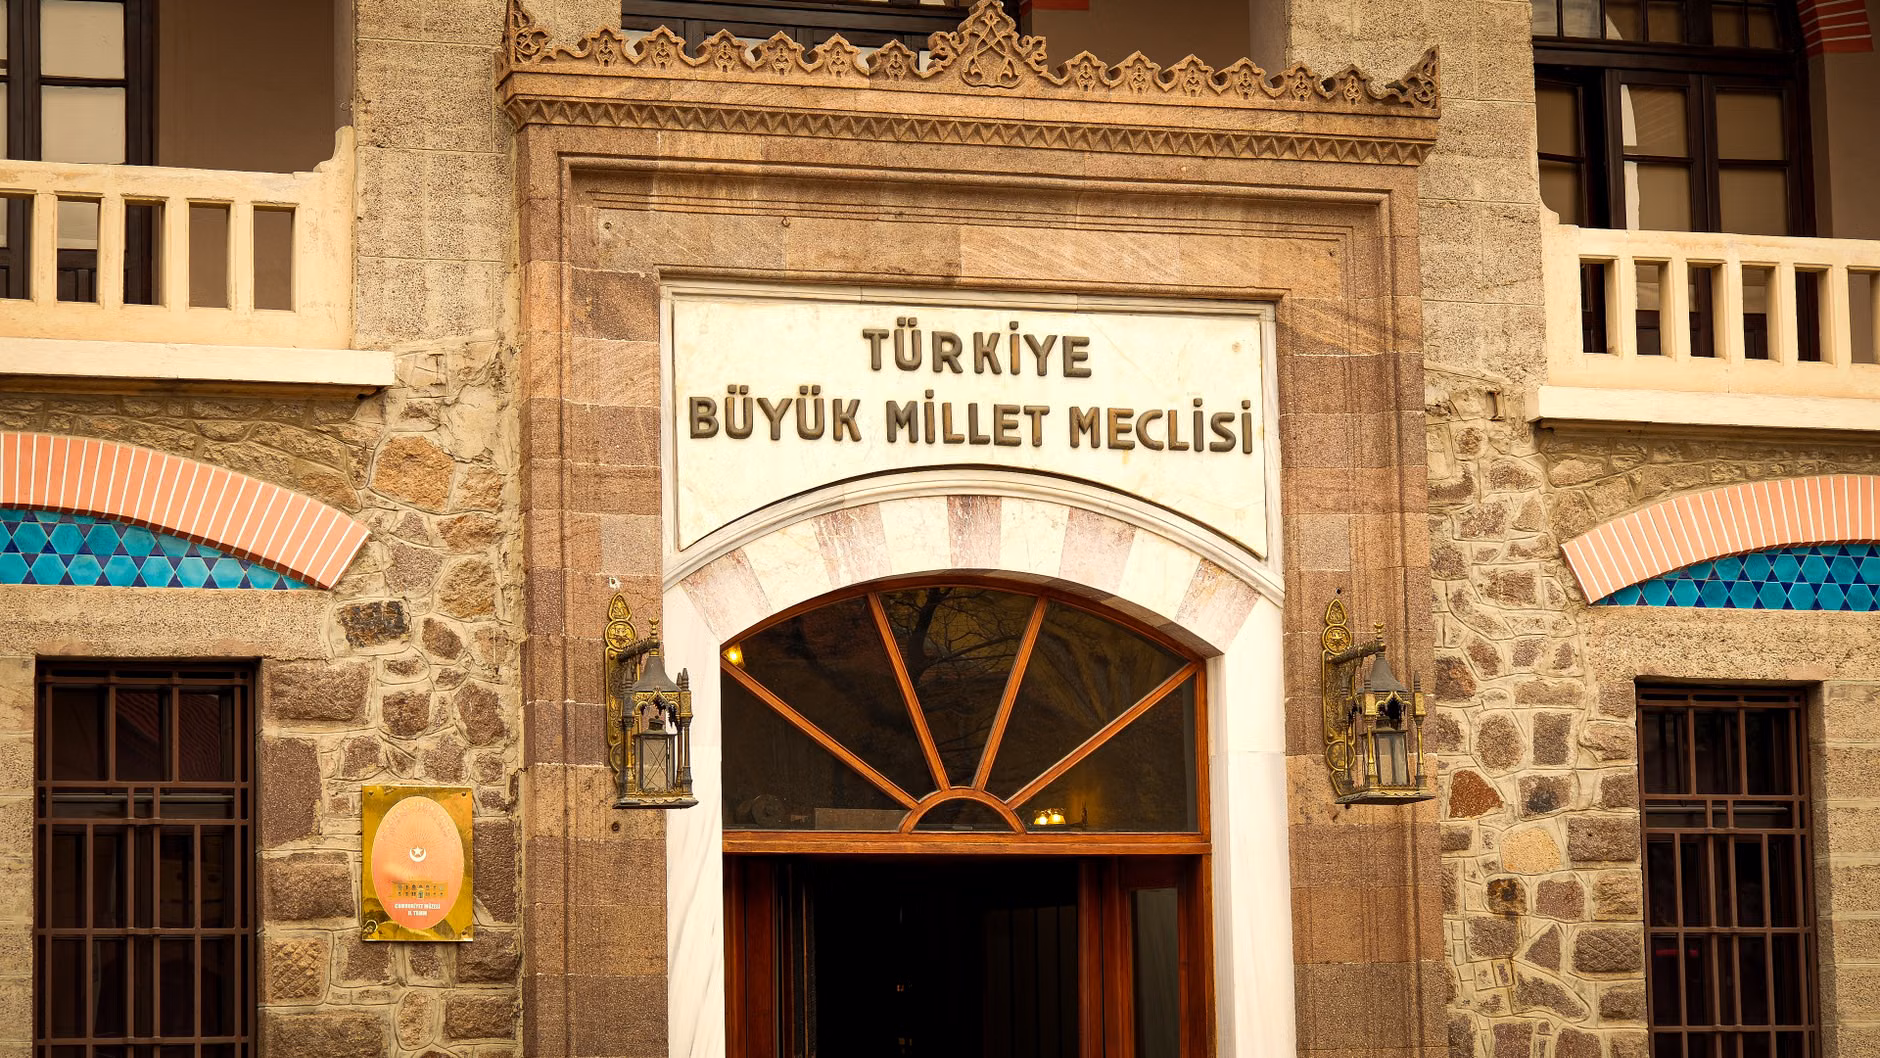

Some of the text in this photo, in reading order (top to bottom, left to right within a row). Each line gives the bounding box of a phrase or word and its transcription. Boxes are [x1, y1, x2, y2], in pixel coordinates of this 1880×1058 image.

[862, 317, 1092, 378] TÜRKİYE
[689, 384, 1253, 454] BÜYÜK MİLLET MECLİSİ
